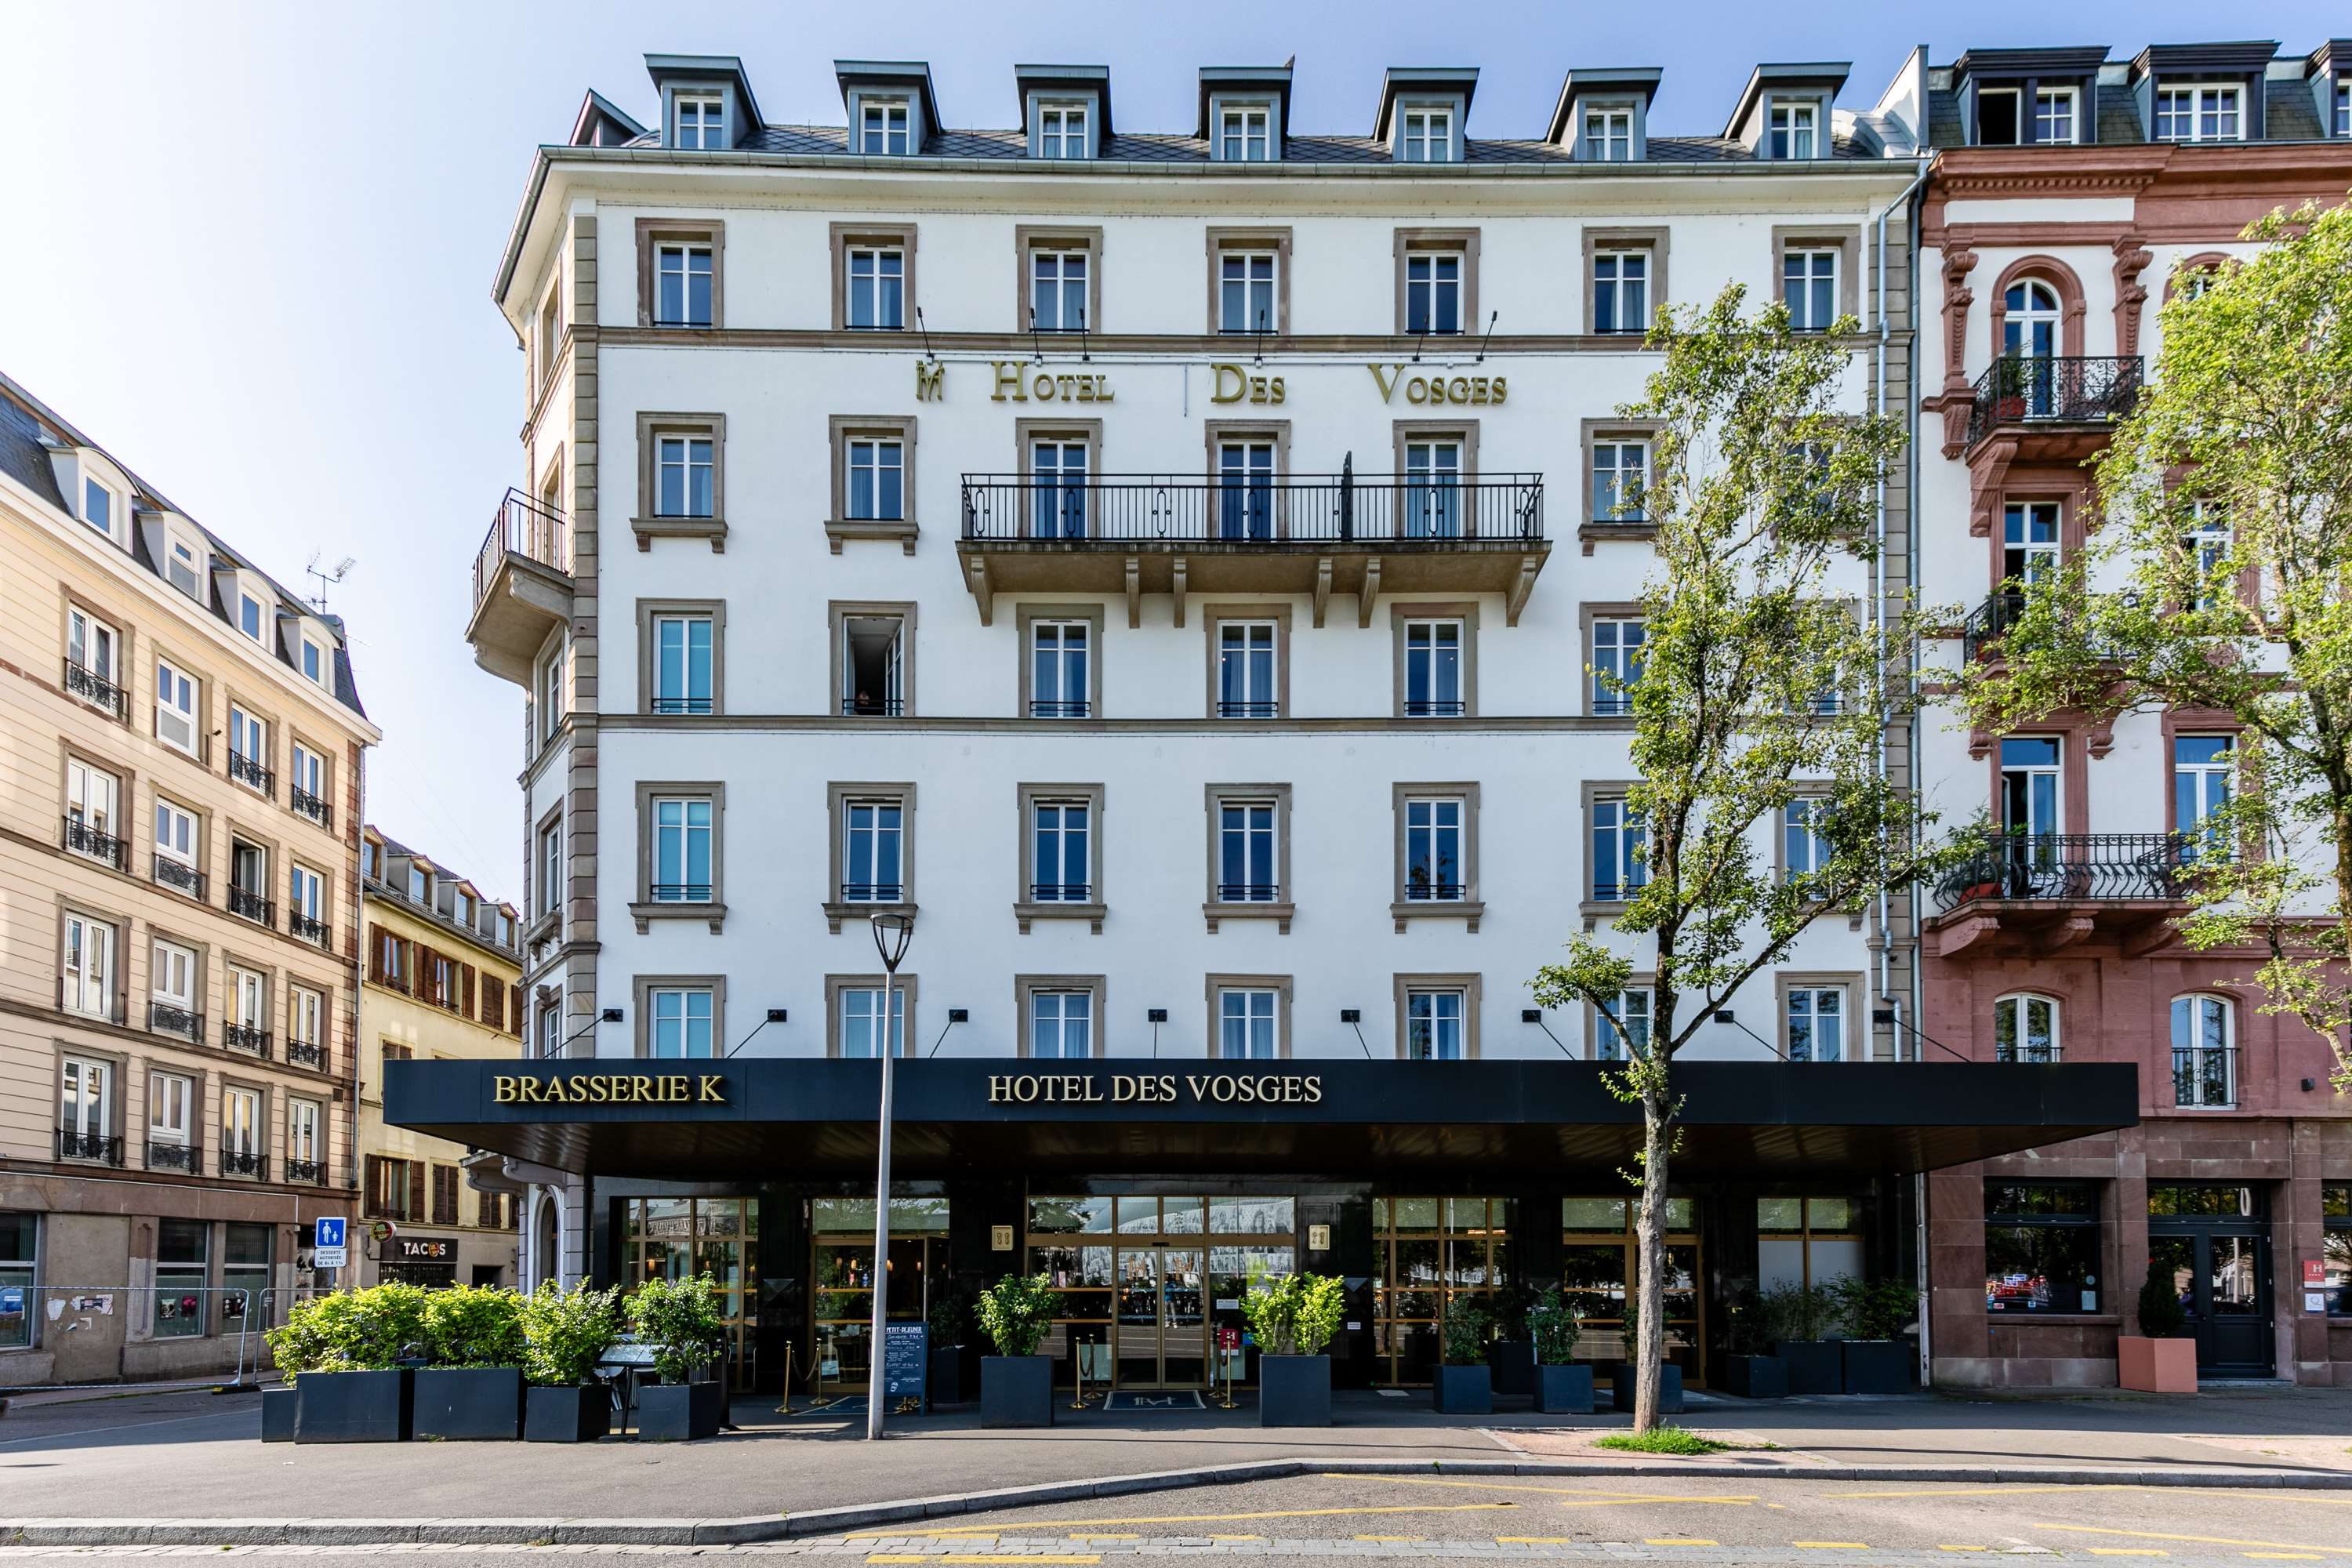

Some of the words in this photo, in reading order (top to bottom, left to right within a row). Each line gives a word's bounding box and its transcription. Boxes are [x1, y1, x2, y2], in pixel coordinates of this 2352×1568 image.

[493, 1075, 691, 1103] BRASSERIE
[698, 1075, 727, 1102] K
[988, 1075, 1104, 1102] HOTEL
[1111, 1075, 1177, 1102] DES
[1185, 1075, 1323, 1103] VOSGES
[2314, 1264, 2322, 1272] H
